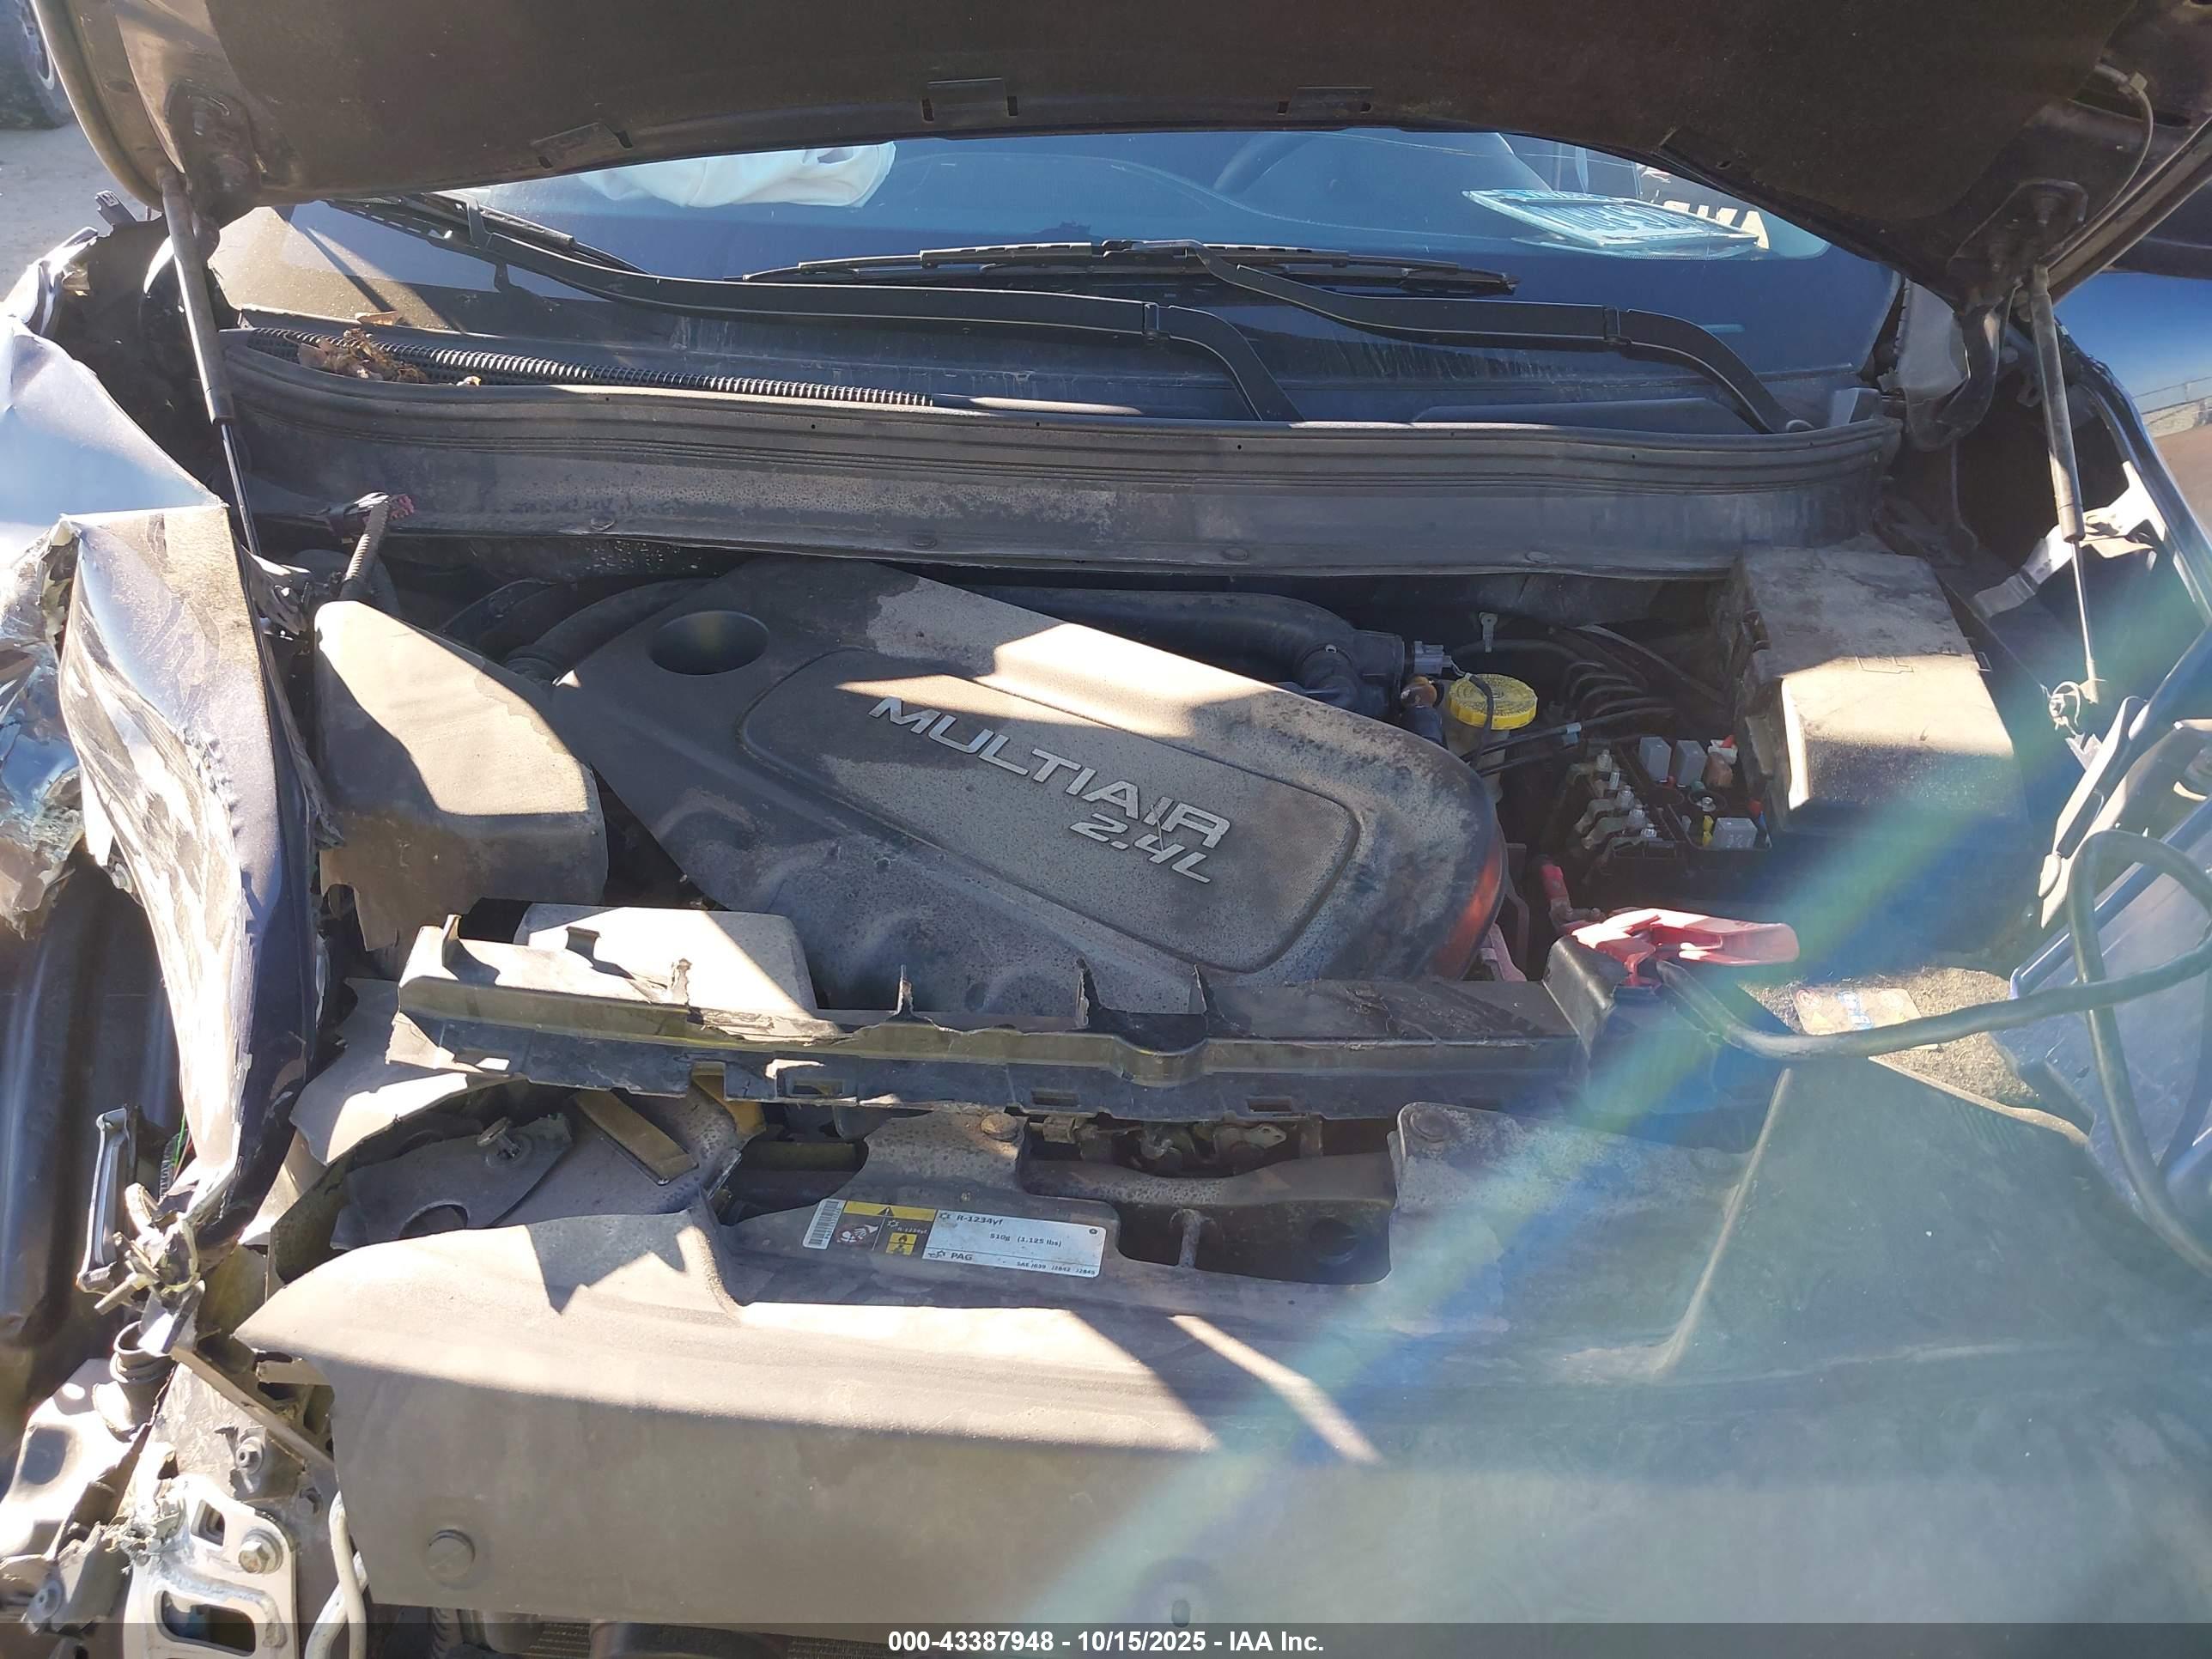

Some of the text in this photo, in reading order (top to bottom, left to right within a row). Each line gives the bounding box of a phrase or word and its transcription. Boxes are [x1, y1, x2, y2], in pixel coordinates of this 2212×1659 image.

[867, 695, 1231, 849] MULTIAIR
[1069, 812, 1212, 885] 2.4L
[956, 1214, 1004, 1226] R-1234yf
[989, 1233, 1062, 1247] 510g (1.125 lbs)
[951, 1252, 973, 1261] PAG
